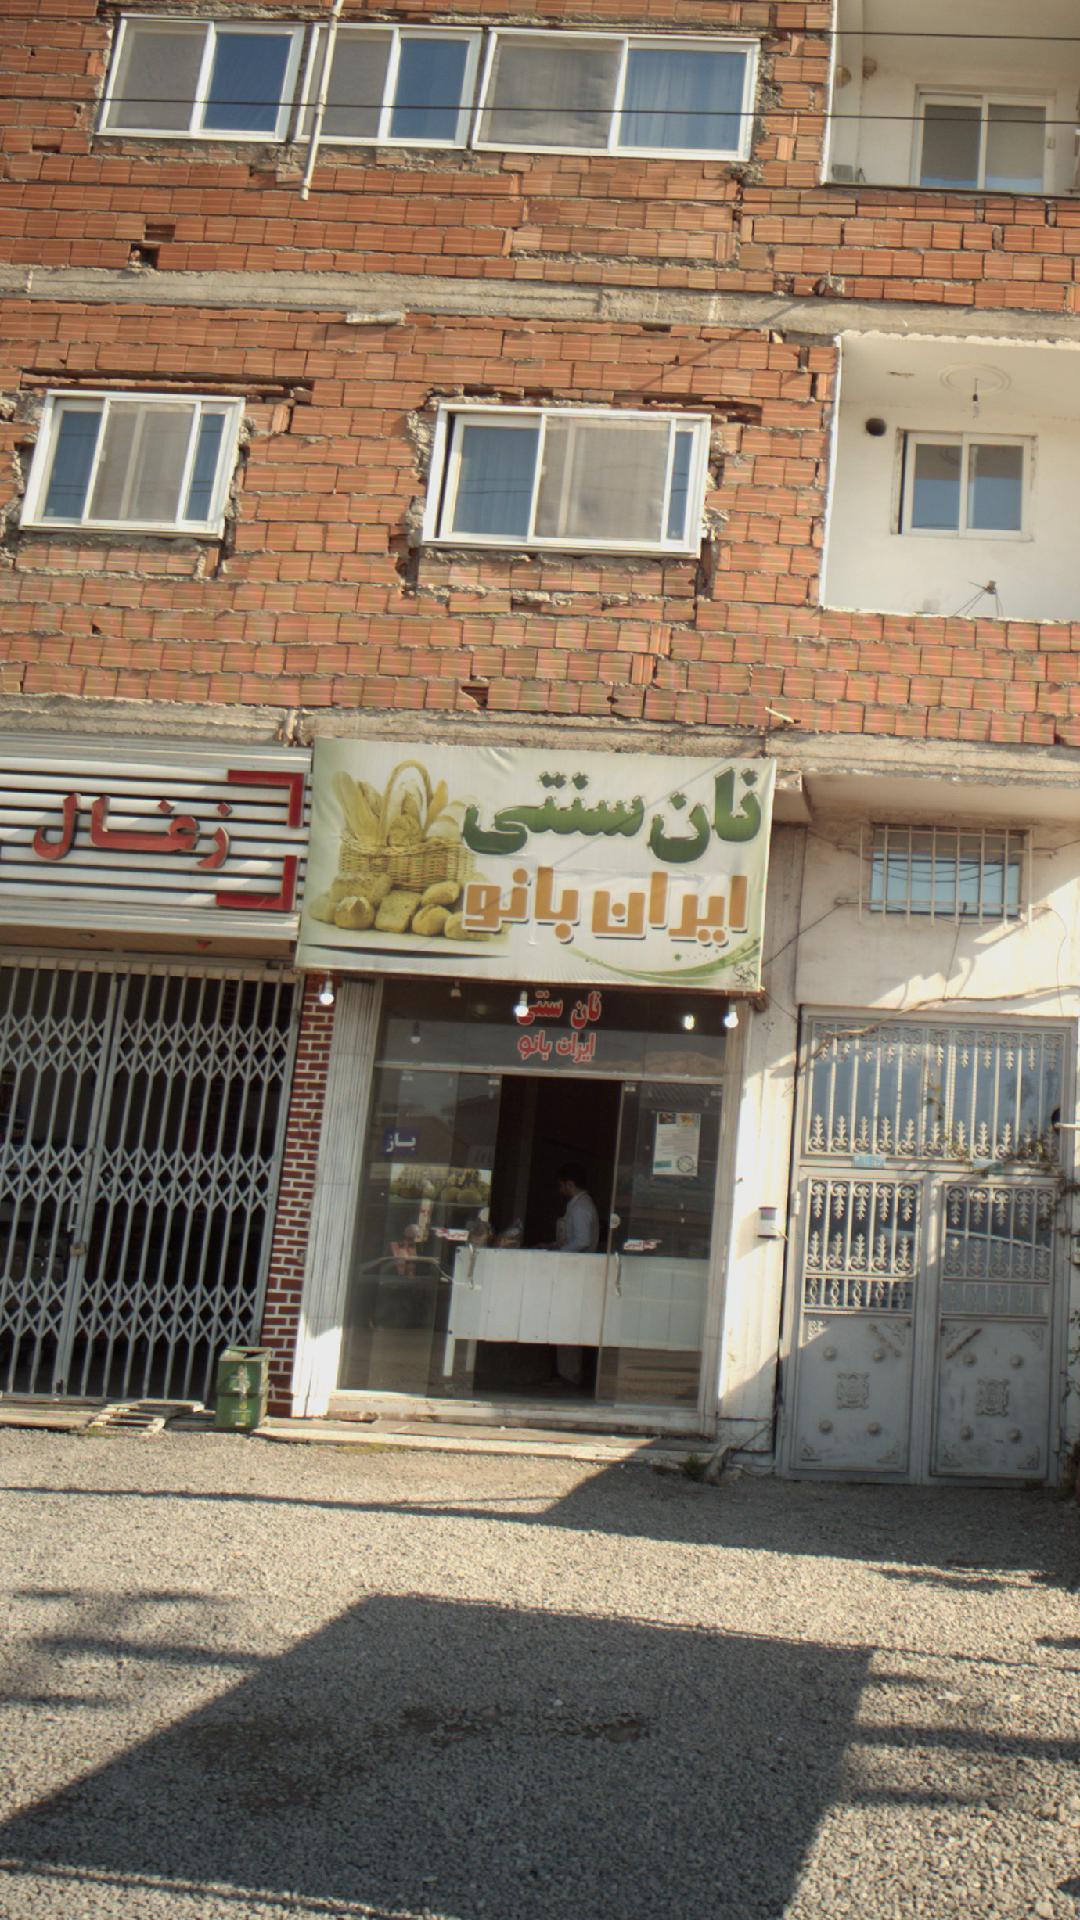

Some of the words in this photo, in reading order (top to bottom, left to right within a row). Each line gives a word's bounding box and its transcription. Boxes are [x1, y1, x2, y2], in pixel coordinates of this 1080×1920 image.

[462, 771, 644, 855] سنتی
[648, 767, 761, 863] نان
[462, 866, 579, 942] بانو
[592, 871, 749, 947] ایران
[571, 990, 602, 1029] نان
[517, 1029, 553, 1061] بانو
[556, 1032, 597, 1064] ایران
[385, 1132, 417, 1153] باز
